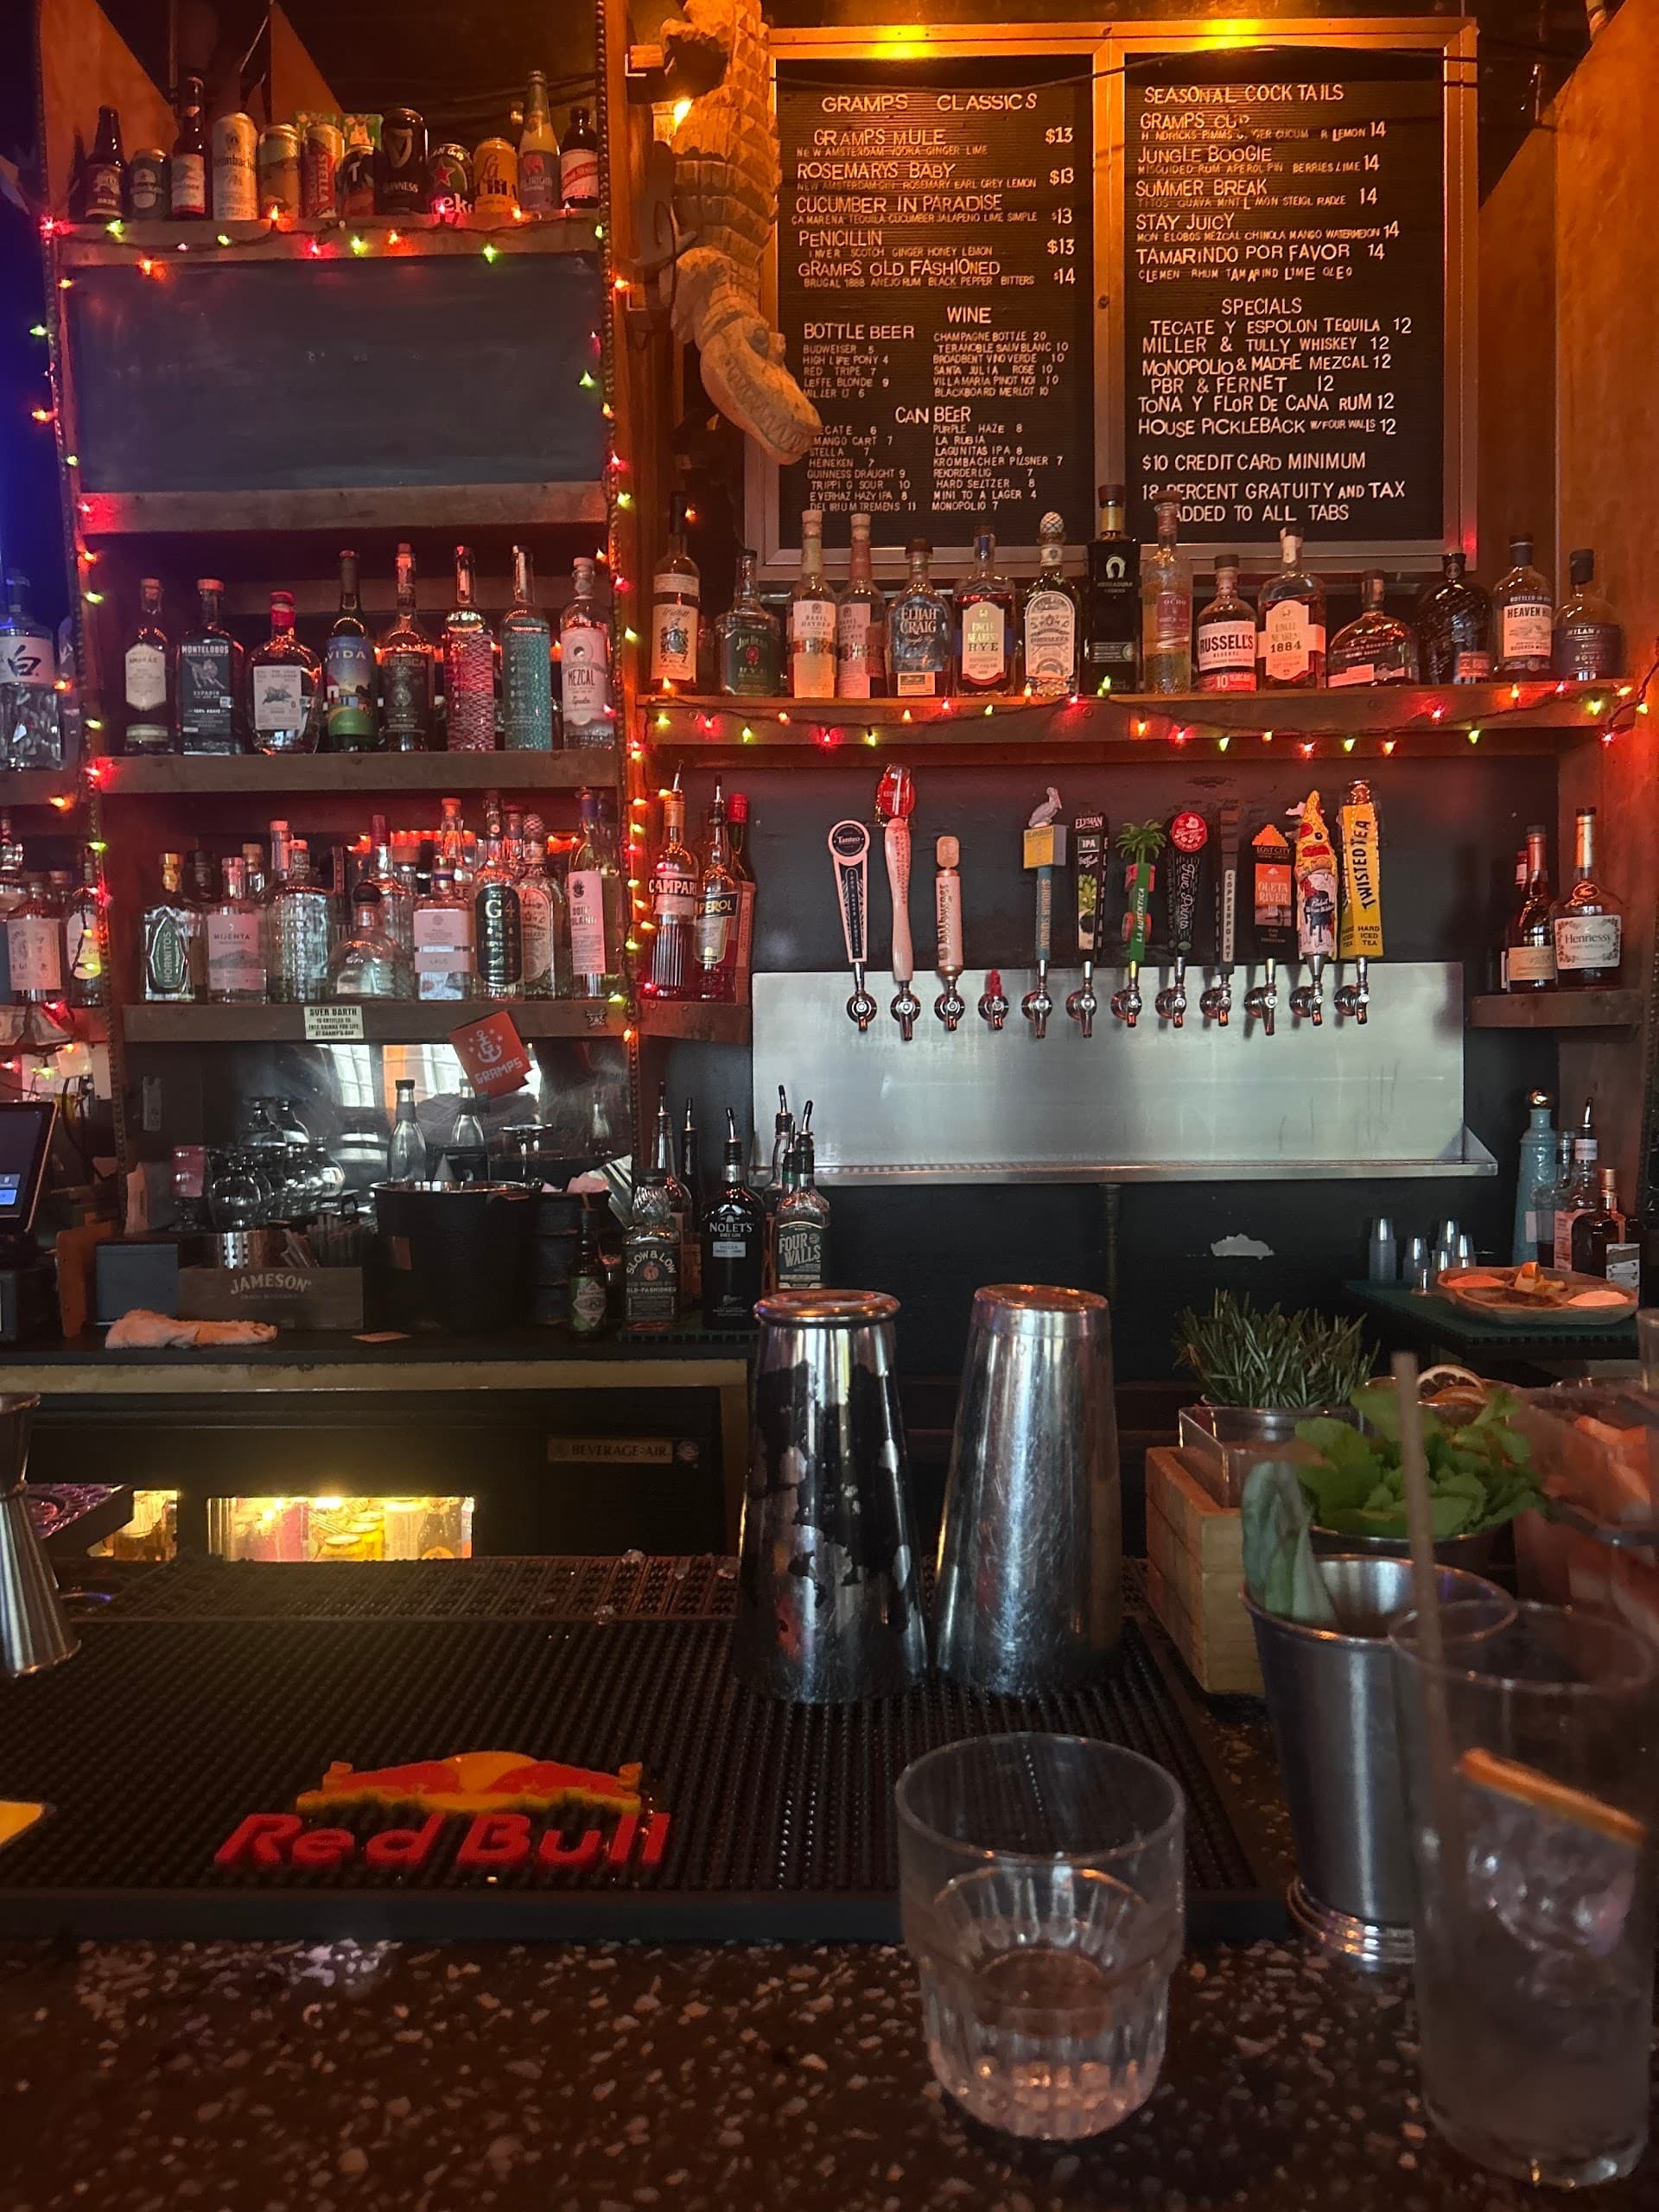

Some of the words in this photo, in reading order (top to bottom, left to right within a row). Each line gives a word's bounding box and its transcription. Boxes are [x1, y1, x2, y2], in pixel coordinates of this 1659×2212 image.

[822, 94, 907, 112] GRAMPS
[937, 93, 1037, 111] CLASSICS
[1144, 86, 1237, 104] SEASONAL
[1245, 84, 1344, 102] COCKTAILS
[1141, 112, 1205, 130] GRAMPS
[1370, 121, 1387, 137] 14
[814, 129, 886, 146] GRAMPS
[893, 129, 946, 145] MULE
[1045, 127, 1073, 144] $13
[1138, 145, 1202, 163] JUNGLE
[1208, 145, 1272, 162] BOOGIE
[1363, 154, 1380, 171] 14
[798, 162, 899, 180] ROSEMARYS
[909, 162, 957, 180] BABY
[1049, 167, 1074, 186] $13
[1007, 178, 1037, 188] LEMON
[1135, 180, 1204, 197] SUMMER
[1214, 179, 1267, 196] BREAK
[1359, 187, 1377, 205] 14
[796, 196, 887, 213] CUCUMBER
[898, 195, 917, 213] IN
[923, 194, 1002, 212] PARADISE
[1052, 207, 1072, 225] $13
[1136, 214, 1180, 231] STAY
[1186, 213, 1235, 231] JUICY
[1383, 220, 1400, 239] 14
[799, 230, 882, 247] PENICILLIN
[1046, 238, 1075, 255] $13
[1135, 246, 1238, 264] TAMARINDO
[1246, 245, 1283, 259] POR
[1289, 243, 1350, 262] FAVOR
[1368, 243, 1385, 260] 14
[798, 259, 862, 276] GRAMPS
[869, 259, 904, 276] OLD
[910, 258, 1001, 276] FASHIONED
[1053, 268, 1076, 284] $14
[1285, 267, 1315, 281] LIME
[947, 306, 992, 324] WINE
[1222, 297, 1302, 315] SPECIALS
[804, 322, 864, 340] BOTTLE
[869, 326, 914, 339] BEER
[1150, 320, 1215, 335] TECATE
[1224, 321, 1236, 334] Y
[1247, 319, 1318, 334] ESPOLON
[1323, 317, 1381, 333] TEQUILA
[1393, 317, 1412, 334] 12
[1142, 336, 1207, 353] MILLER
[1220, 336, 1232, 353] &
[1245, 338, 1291, 353] TULLY
[1299, 337, 1357, 351] WHISKEY
[1370, 335, 1389, 350] 12
[803, 356, 824, 365] HIGH
[1012, 365, 1034, 374] ROSE
[1142, 359, 1234, 377] MONOPOLIO
[1236, 357, 1247, 372] &
[1251, 353, 1302, 371] MADRE
[1309, 355, 1369, 371] MEZCAL
[1373, 353, 1391, 369] 12
[804, 366, 823, 376] RED
[836, 378, 873, 387] BLONDE
[1151, 378, 1184, 394] PBR
[1197, 378, 1209, 393] &
[1217, 374, 1287, 394] FERNET
[1318, 374, 1334, 392] 12
[934, 387, 995, 397] BLACKBOARD
[1138, 396, 1182, 414] TONA
[1192, 396, 1203, 412] Y
[1213, 395, 1253, 412] FLOR
[1286, 394, 1329, 412] CANA
[1339, 393, 1372, 411] RUM
[1376, 392, 1395, 410] 12
[895, 406, 929, 423] CAN
[934, 406, 971, 423] BEER
[978, 423, 1004, 433] HAZE
[1138, 418, 1195, 438] HOUSE
[1202, 416, 1306, 435] PICKLEBACK
[1380, 418, 1396, 435] 12
[852, 436, 877, 446] CART
[954, 435, 985, 445] RUBIA
[935, 447, 988, 456] LAGUNITAS
[992, 446, 1011, 454] IPA
[933, 457, 1005, 467] KROMBACHER
[1009, 456, 1048, 466] PILSNER
[1141, 454, 1168, 471] $10
[1174, 454, 1234, 471] CREDIT
[1236, 454, 1281, 471] CARD
[1288, 452, 1365, 470] MINIMUM
[807, 469, 852, 479] GUINNESS
[855, 468, 894, 479] DRAUGHT
[937, 480, 963, 489] HARD
[968, 479, 1010, 488] SELTZER
[1141, 484, 1160, 500] 18
[1245, 482, 1334, 499] GRATUITY
[1338, 485, 1364, 499] AND
[1368, 480, 1406, 499] TAX
[993, 490, 1022, 499] LAGER
[1234, 505, 1253, 521] TO
[1262, 505, 1297, 522] ALL
[1308, 505, 1349, 521] TABS
[1507, 607, 1541, 619] HEAVEN
[900, 620, 936, 635] CRAIG
[968, 642, 998, 652] RYE
[1199, 634, 1254, 654] RUSSELL'S
[1270, 640, 1302, 653] 1884
[327, 650, 366, 660] VIDA
[568, 670, 595, 687] MEZCAL
[1217, 676, 1228, 689] 10
[1350, 820, 1370, 845] TEA
[1082, 839, 1096, 849] IPA
[1351, 845, 1376, 910] TWISTED
[1258, 881, 1288, 893] OLETA
[1136, 887, 1145, 927] AUTENTICA
[1259, 893, 1288, 903] RIVER
[1136, 929, 1142, 942] LA
[1566, 933, 1611, 944] Hennessy
[164, 931, 173, 986] HORNITOS
[475, 1059, 523, 1085] GRAMPS
[709, 1222, 753, 1233] NOLET'S
[779, 1233, 808, 1254] FOUR
[626, 1250, 649, 1274] SLOW
[651, 1249, 658, 1258] &
[658, 1253, 677, 1273] LOW
[784, 1244, 822, 1268] WALLS
[231, 1273, 308, 1294] JAMESON
[214, 1813, 447, 1867] Red
[457, 1811, 671, 1867] Bull
